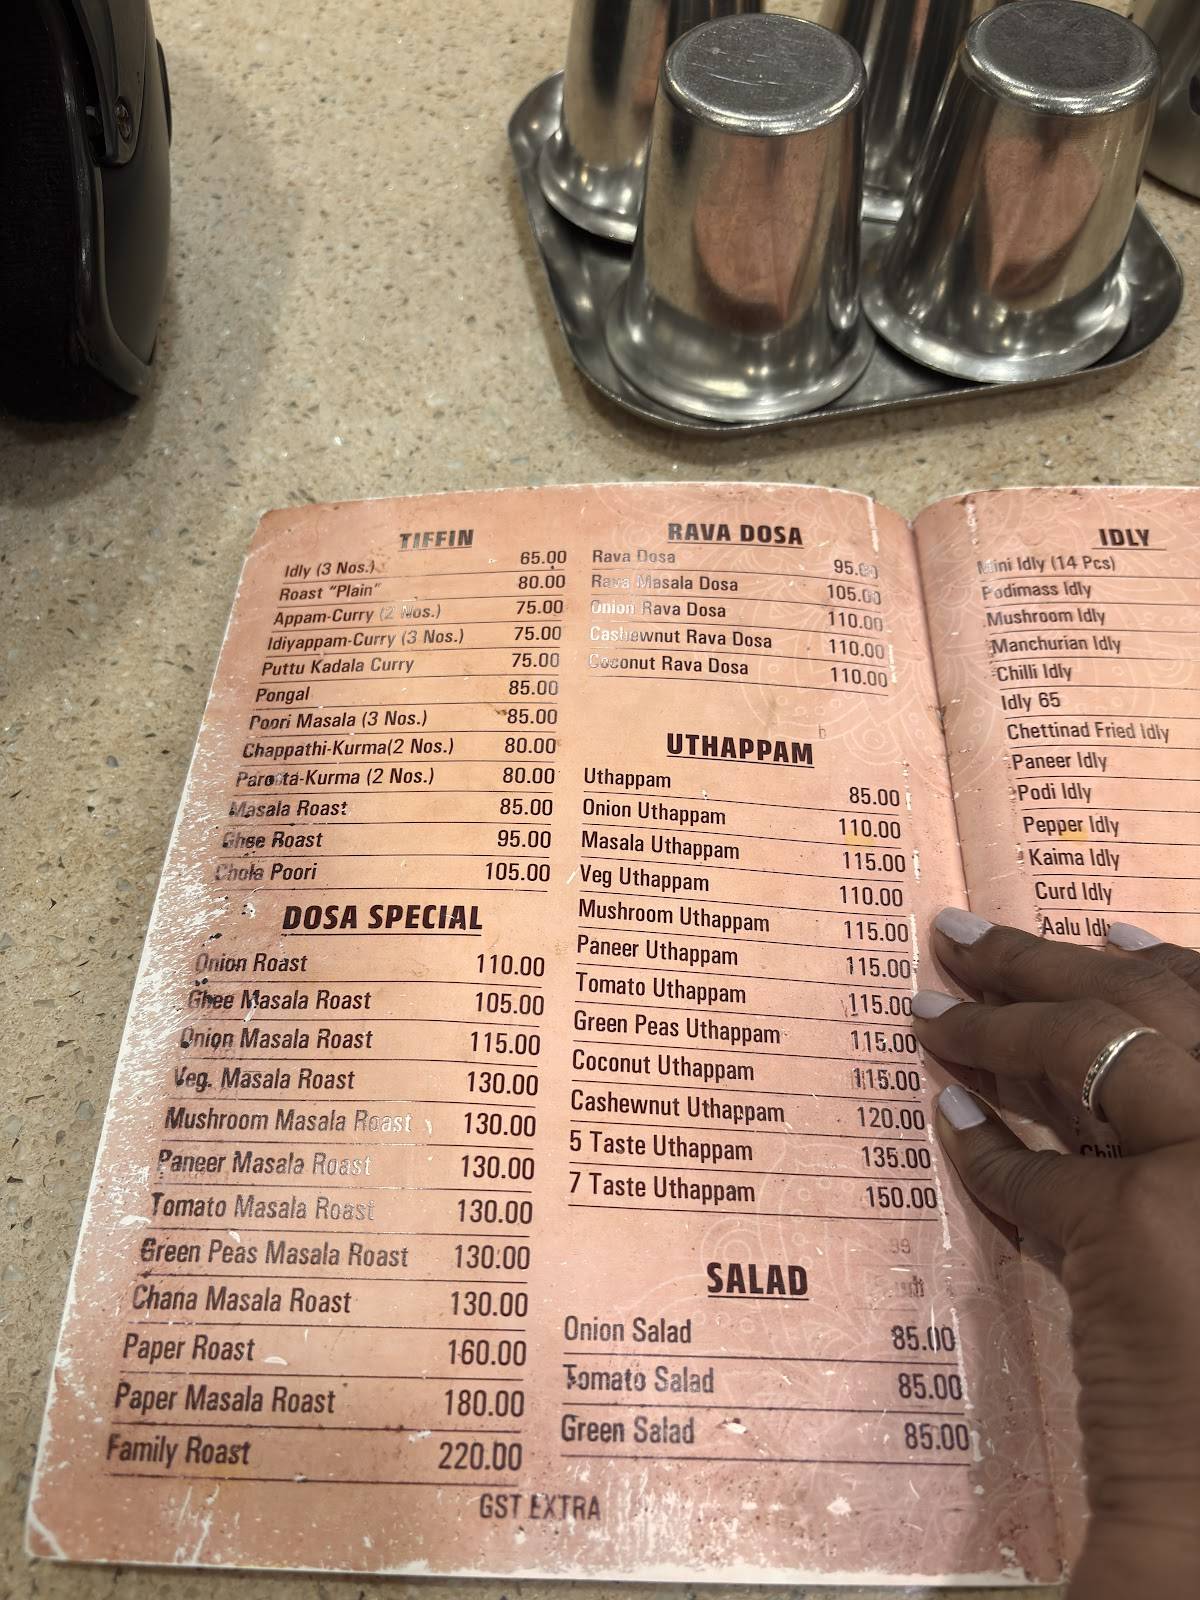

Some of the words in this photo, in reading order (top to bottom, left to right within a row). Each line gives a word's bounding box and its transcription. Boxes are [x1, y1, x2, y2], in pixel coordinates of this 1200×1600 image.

[400, 529, 474, 549] TIFFIN
[668, 523, 731, 542] RAVA
[740, 525, 803, 545] DOSA
[1099, 529, 1149, 546] IDLY
[285, 564, 311, 579] Idly
[317, 562, 334, 577] (3
[338, 560, 375, 574] Nos.)
[520, 551, 566, 565] 65.00
[1017, 557, 1045, 573] Idly
[1051, 557, 1078, 571] (14
[1082, 556, 1116, 571] Pcs)
[279, 587, 322, 601] Roast
[518, 575, 565, 589] 80.00
[700, 577, 738, 592] Dosa
[1064, 582, 1091, 599] Idly
[273, 608, 374, 628] Appam-Curry
[516, 600, 563, 614] 75.00
[687, 603, 726, 618] Dosa
[986, 610, 1073, 626] Mushroom
[1077, 608, 1105, 625] Idly
[267, 632, 396, 652] Idiyappam-Curry
[423, 629, 464, 644] Nos.)
[514, 626, 561, 641] 75.00
[686, 630, 725, 646] Rava
[732, 632, 772, 648] Dosa
[829, 639, 884, 659] 110.00
[1092, 636, 1121, 653] Idly
[262, 661, 304, 676] Puttu
[311, 659, 364, 674] Kadala
[512, 653, 559, 668] 75.00
[661, 656, 702, 672] Rava
[708, 658, 748, 675] Dosa
[830, 667, 888, 688] 110.00
[996, 665, 1038, 682] Chilli
[1043, 664, 1071, 682] Idly
[255, 687, 310, 705] Pongal
[508, 680, 558, 696] 85.00
[1001, 694, 1031, 711] Idly
[1038, 692, 1061, 708] 65
[296, 713, 356, 729] Masala
[362, 712, 378, 728] (3
[384, 711, 427, 727] Nos.)
[507, 709, 557, 724] 85.00
[1007, 722, 1090, 740] Chettinad
[1095, 722, 1136, 739] Fried
[1140, 724, 1169, 743] Idly
[410, 738, 454, 754] Nos.)
[504, 738, 556, 753] 80.00
[667, 733, 813, 765] UTHAPPAM
[1012, 754, 1072, 770] Paneer
[1077, 752, 1107, 772] Idly
[366, 769, 384, 785] (2
[389, 768, 434, 785] Nos.)
[502, 768, 555, 783] 80.00
[584, 768, 671, 789] Uthappam
[849, 787, 899, 806] 85.00
[1017, 783, 1056, 801] Podi
[1061, 783, 1091, 803] Idly
[296, 800, 348, 816] Roast
[500, 799, 552, 816] 85.00
[583, 799, 631, 818] Onion
[638, 802, 726, 826] Uthappam
[839, 818, 901, 839] 110.00
[497, 831, 551, 848] 95.00
[1023, 816, 1083, 836] Pepper
[1088, 816, 1119, 837] Idly
[581, 831, 644, 852] Masala
[651, 836, 739, 859] Uthappam
[842, 852, 905, 872] 115.00
[1028, 848, 1084, 866] Kaima
[1089, 849, 1119, 871] Idly
[271, 863, 317, 880] Poori
[486, 862, 550, 881] 105.00
[580, 864, 612, 887] Veg
[619, 866, 709, 892] Uthappam
[840, 886, 902, 908] 110.00
[1035, 881, 1077, 900] Curd
[1082, 882, 1112, 905] Idly
[282, 905, 358, 930] DOSA
[367, 904, 483, 930] SPECIAL
[579, 899, 673, 924] Mushroom
[680, 906, 769, 932] Uthappam
[844, 921, 908, 942] 115.00
[1042, 917, 1080, 936] Aalu
[252, 952, 307, 972] Roast
[476, 954, 545, 977] 110.00
[577, 934, 639, 957] Paneer
[646, 939, 738, 966] Uthappam
[846, 957, 911, 979] 115.00
[576, 972, 646, 996] Tomato
[653, 978, 746, 1004] Uthappam
[315, 989, 371, 1010] Roast
[475, 992, 544, 1015] 105.00
[574, 1011, 628, 1034] Green
[635, 1014, 679, 1037] Peas
[686, 1018, 781, 1044] Uthappam
[240, 1028, 309, 1048] Masala
[316, 1028, 372, 1049] Roast
[470, 1031, 540, 1055] 115.00
[572, 1049, 651, 1074] Coconut
[658, 1055, 754, 1081] Uthappam
[221, 1067, 291, 1088] Masala
[298, 1068, 354, 1088] Roast
[466, 1071, 538, 1096] 130.00
[165, 1106, 268, 1130] Mushroom
[275, 1109, 345, 1131] Masala
[463, 1112, 536, 1136] 130.00
[571, 1089, 680, 1116] Cashewnut
[687, 1096, 784, 1124] Uthappam
[857, 1107, 925, 1130] 120.00
[570, 1130, 581, 1151] 5
[589, 1131, 646, 1155] Taste
[653, 1134, 752, 1163] Uthappam
[862, 1146, 931, 1169] 135.00
[460, 1155, 534, 1180] 130.00
[569, 1171, 581, 1193] 7
[589, 1172, 646, 1197] Taste
[654, 1176, 755, 1204] Uthappam
[866, 1186, 937, 1209] 150.00
[150, 1193, 226, 1217] Tomato
[457, 1199, 533, 1224] 130.00
[208, 1239, 257, 1265] Peas
[265, 1241, 340, 1267] Masala
[349, 1242, 408, 1268] Roast
[454, 1244, 530, 1270] 130.00
[708, 1262, 808, 1295] SALAD
[132, 1285, 197, 1311] Chana
[205, 1286, 282, 1312] Masala
[290, 1289, 351, 1314] Roast
[450, 1291, 528, 1317] 130.00
[564, 1316, 625, 1342] Onion
[632, 1318, 692, 1344] Salad
[123, 1333, 185, 1364] Paper
[192, 1334, 255, 1361] Roast
[448, 1339, 526, 1366] 160.00
[115, 1382, 181, 1415] Paper
[185, 1383, 263, 1413] Masala
[272, 1387, 336, 1414] Roast
[444, 1389, 524, 1417] 180.00
[899, 1373, 962, 1400] 85.00
[561, 1415, 625, 1443] Green
[633, 1417, 695, 1444] Salad
[904, 1423, 969, 1451] 85.00
[106, 1433, 178, 1469] Family
[185, 1437, 250, 1465] Roast
[438, 1442, 522, 1471] 220.00
[479, 1493, 523, 1519] GST
[530, 1494, 601, 1521] EXTRA
